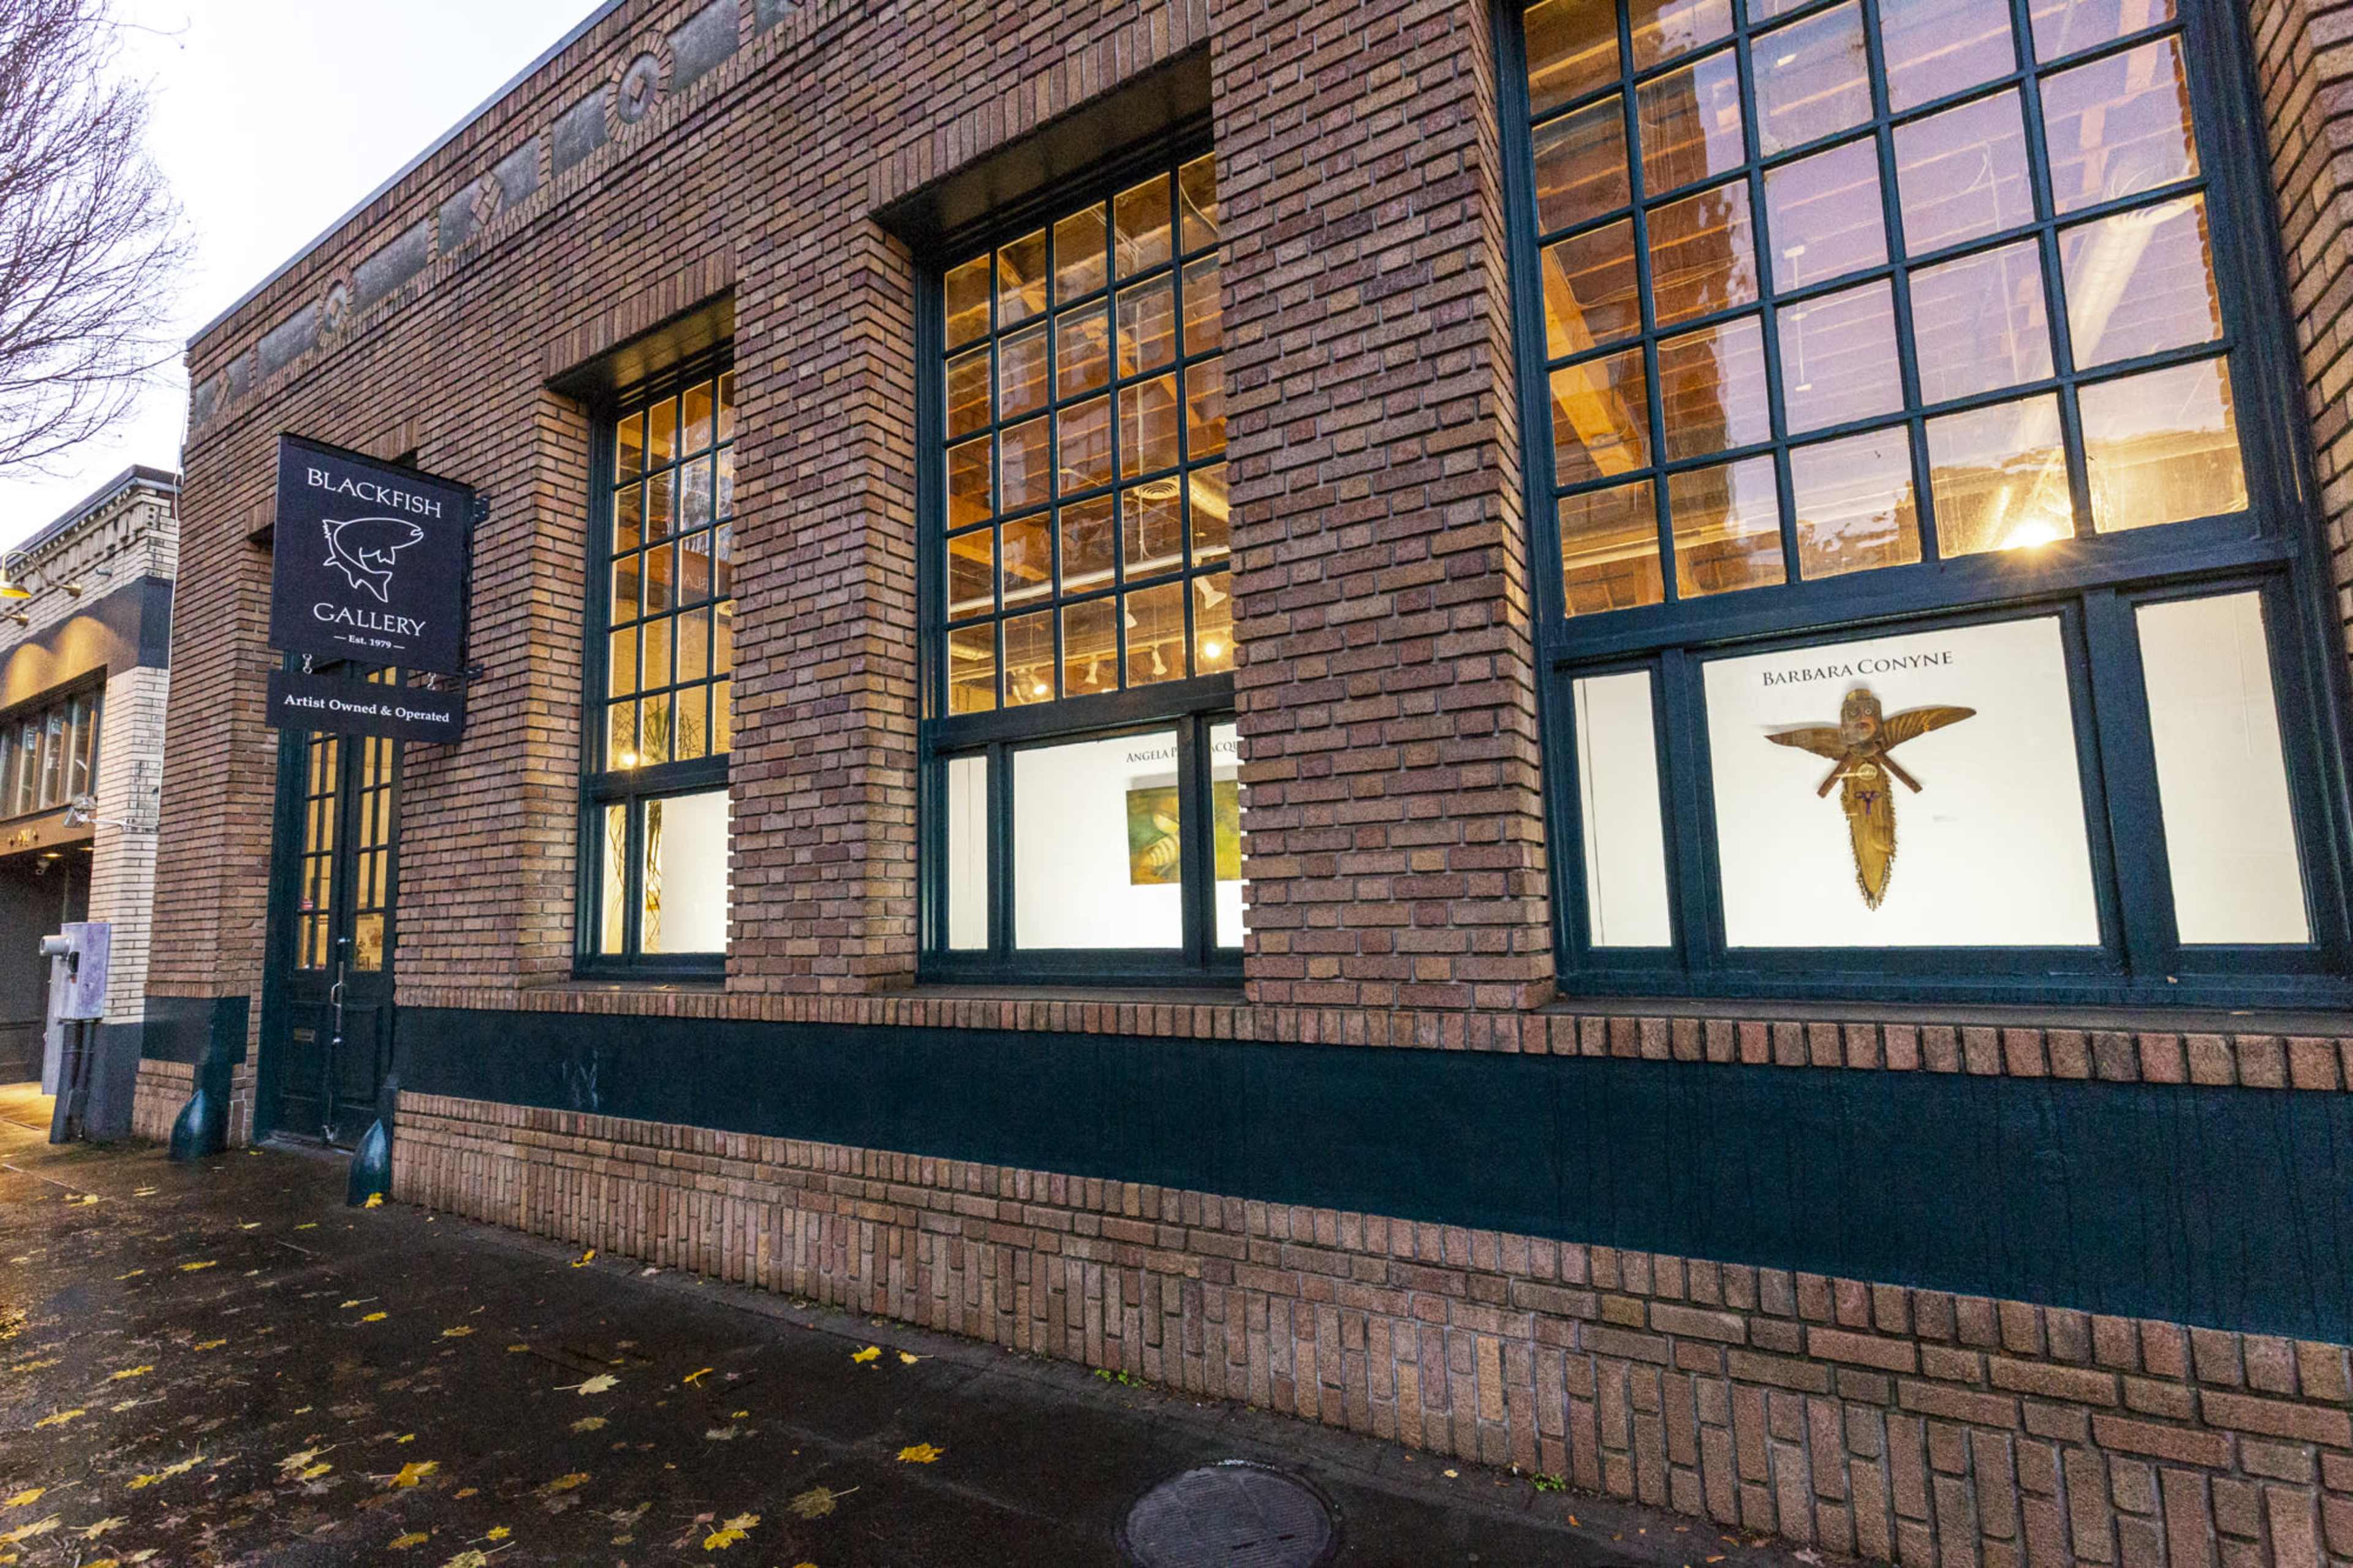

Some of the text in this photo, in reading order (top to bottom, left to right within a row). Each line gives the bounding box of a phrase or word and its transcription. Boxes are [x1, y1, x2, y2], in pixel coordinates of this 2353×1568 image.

[307, 468, 442, 518] BLACKFISH
[313, 602, 426, 637] GALLERY
[348, 635, 392, 649] Est. 1979
[1762, 651, 1954, 686] BARBARA CONYNE
[284, 694, 450, 723] Artist Owned & Operated
[1126, 748, 1169, 763] ANGELA
